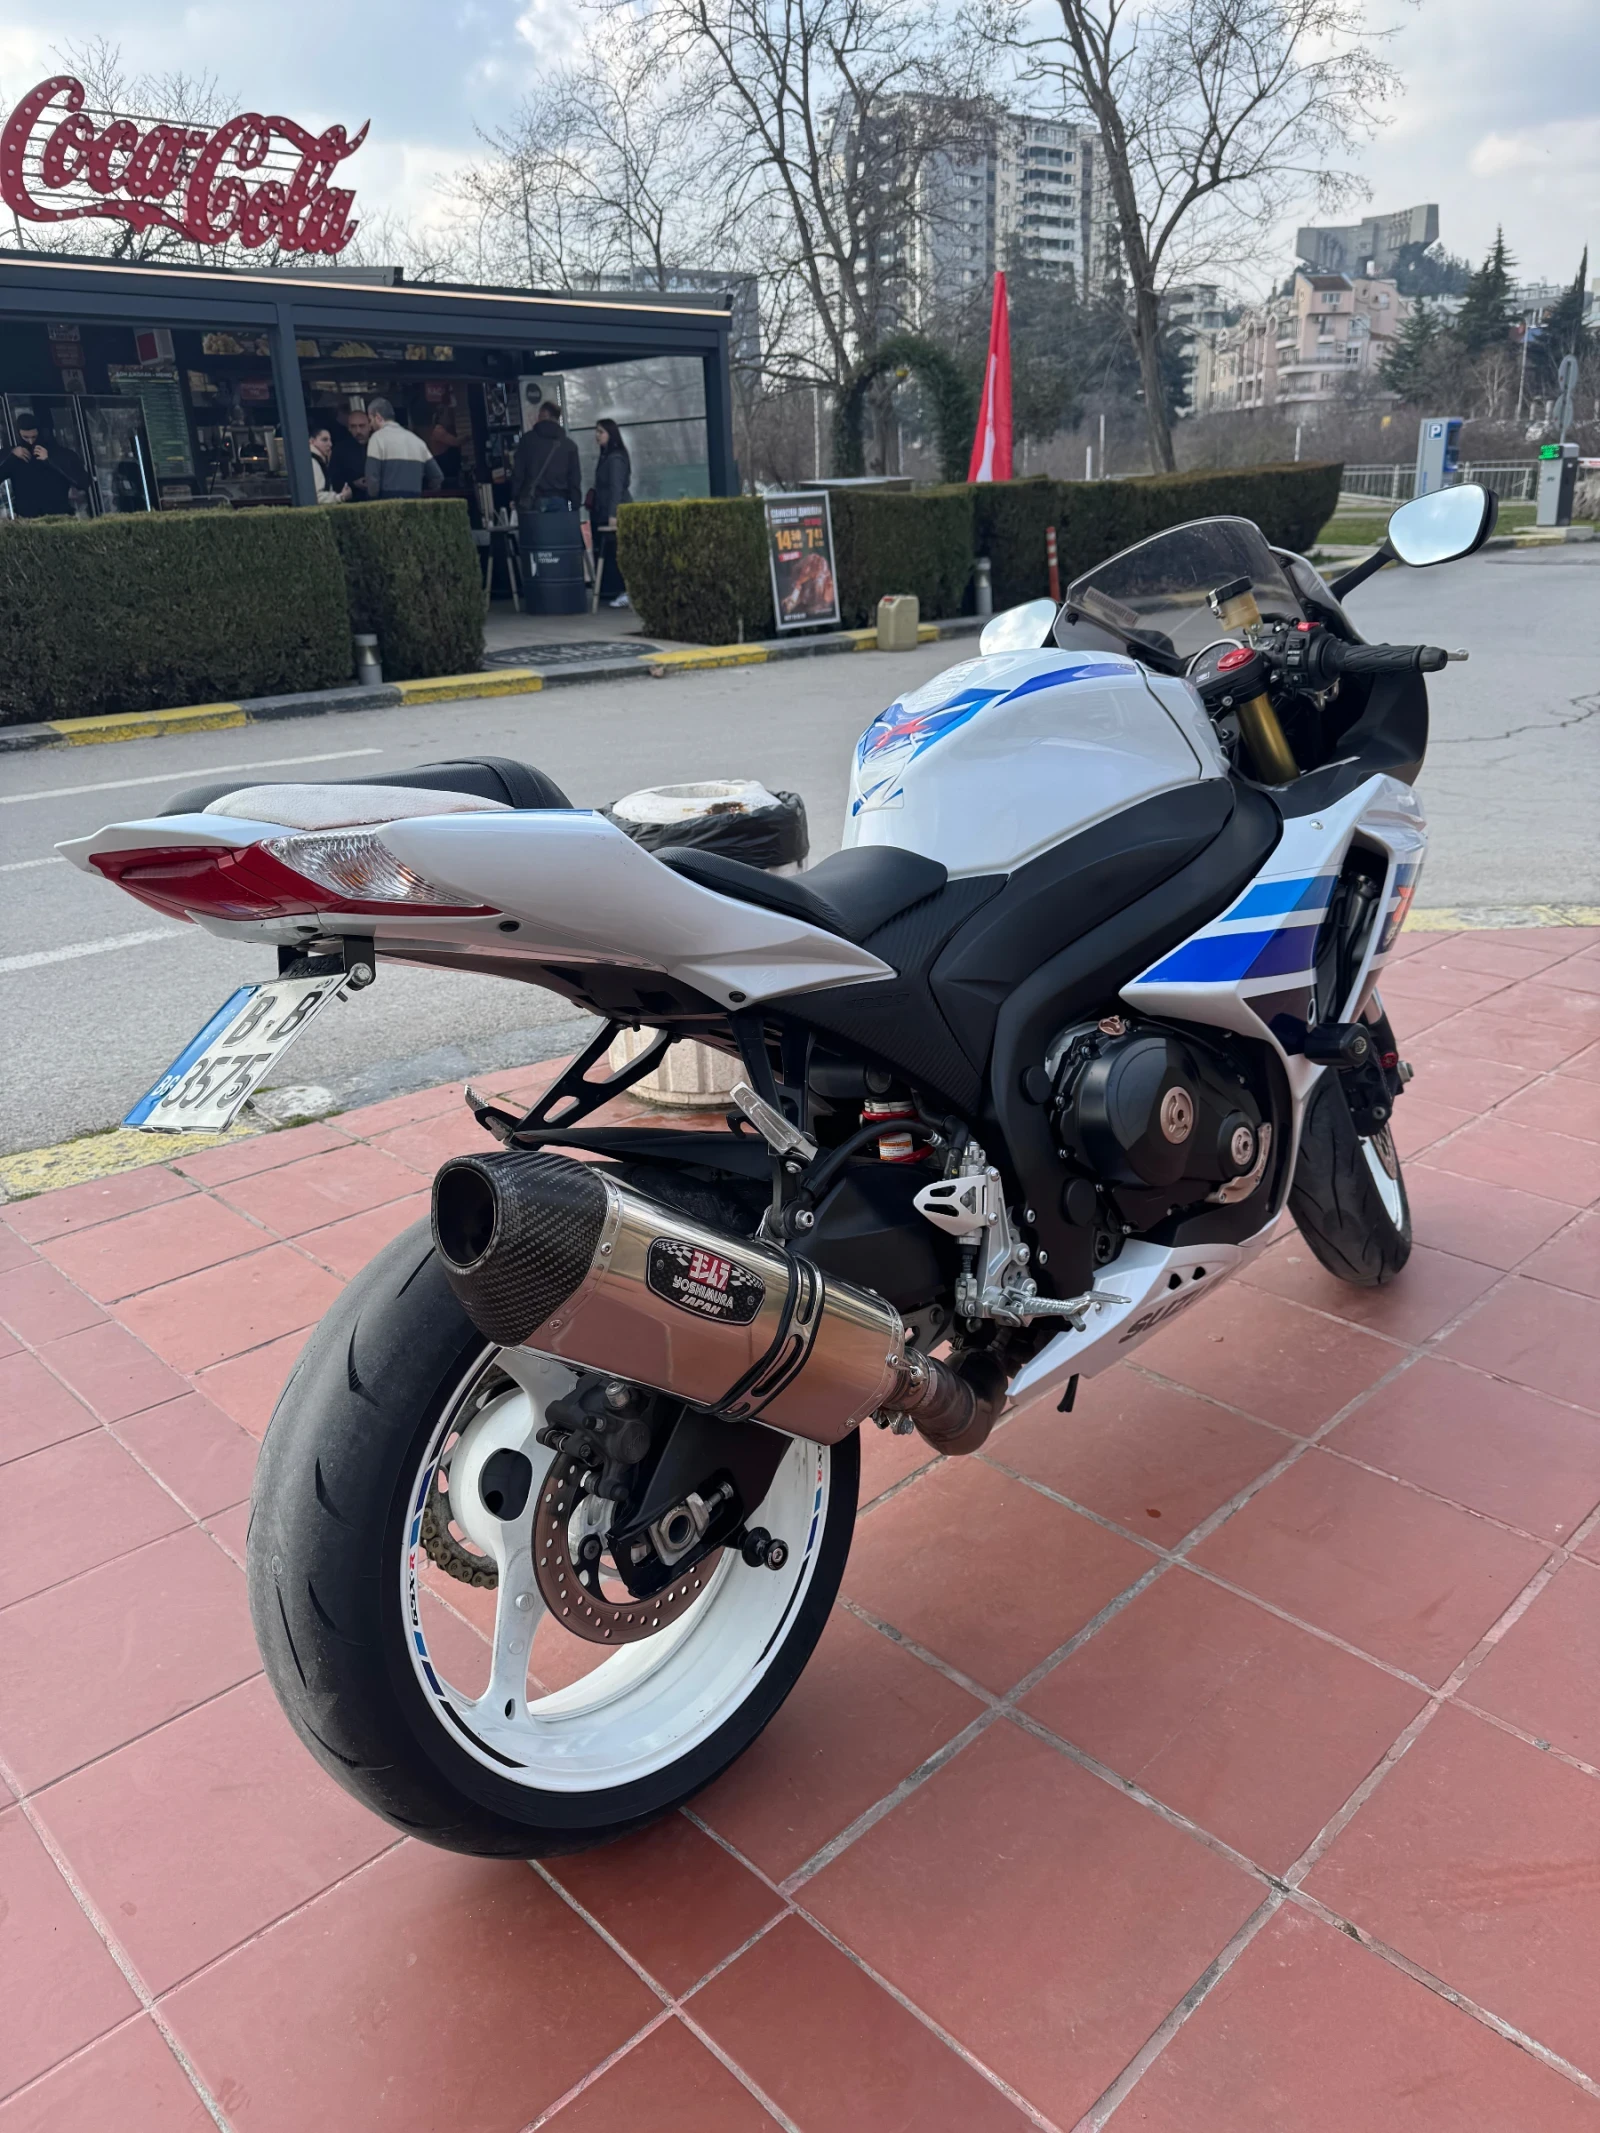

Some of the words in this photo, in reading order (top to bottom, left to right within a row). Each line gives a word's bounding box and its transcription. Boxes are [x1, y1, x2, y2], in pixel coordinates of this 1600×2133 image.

[0, 75, 370, 255] Coca-Cola
[150, 1074, 180, 1097] BG
[161, 1053, 272, 1109] 3575
[672, 1275, 734, 1310] YOSHIMURA
[680, 1294, 722, 1316] JAPAN
[409, 1552, 418, 1626] GSX-R
